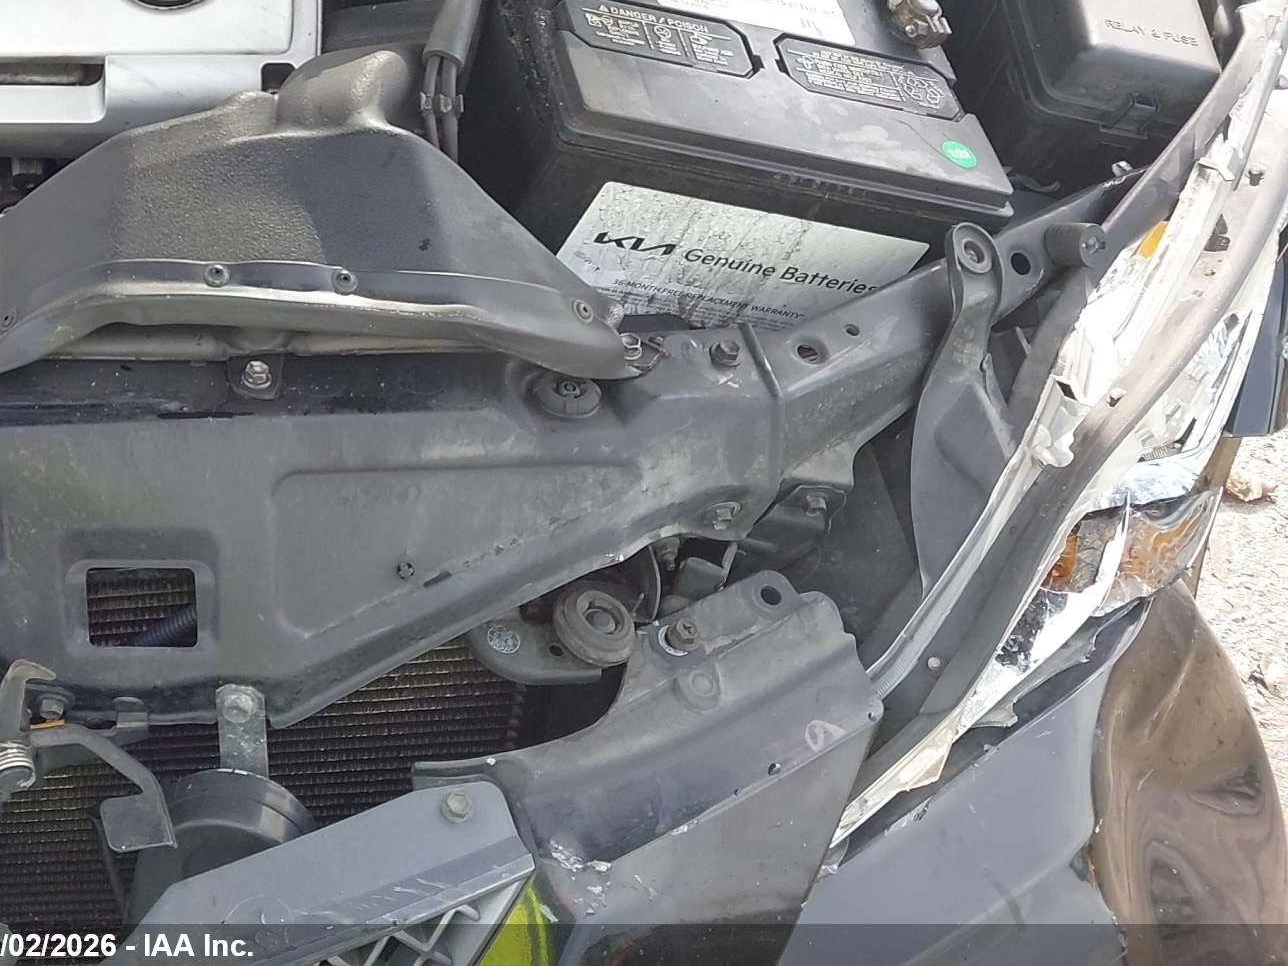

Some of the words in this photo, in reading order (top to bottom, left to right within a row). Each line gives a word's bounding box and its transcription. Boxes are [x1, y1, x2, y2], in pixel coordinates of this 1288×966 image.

[611, 7, 657, 23] DANGER
[668, 18, 709, 34] POISON
[1104, 19, 1145, 35] RELAY
[1163, 31, 1199, 46] FUSE
[683, 248, 776, 278] Genuine
